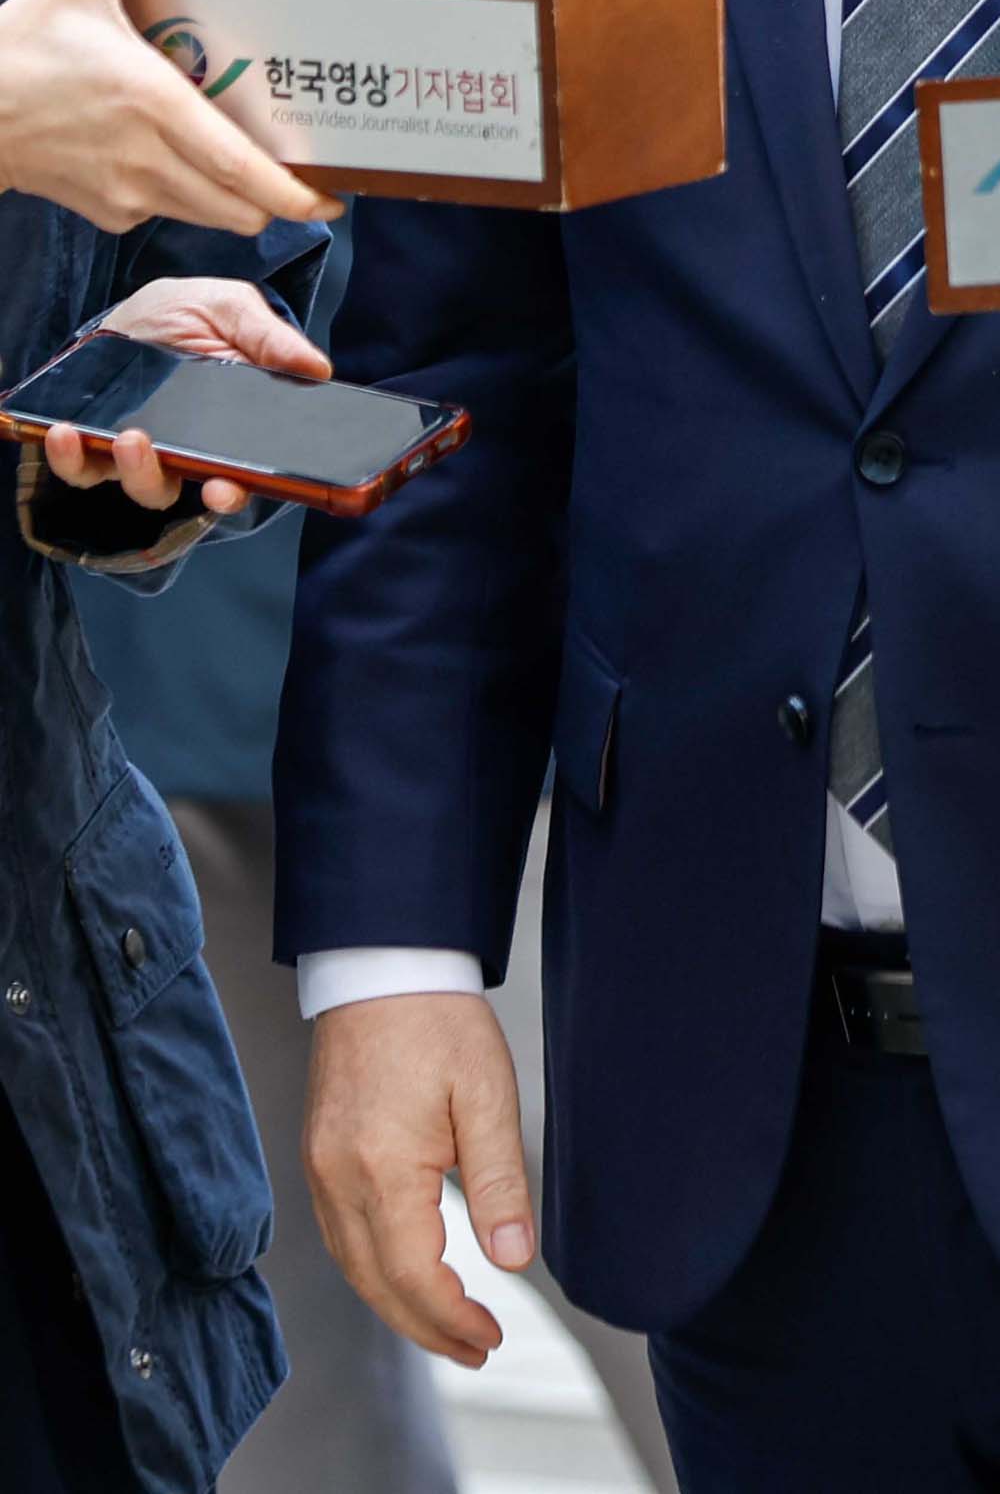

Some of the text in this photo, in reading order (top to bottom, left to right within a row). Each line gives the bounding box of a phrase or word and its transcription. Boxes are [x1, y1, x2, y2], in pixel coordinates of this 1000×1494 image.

[264, 57, 517, 116] 한국영상기자협회
[271, 107, 519, 141] Korea Video Journalist Association
